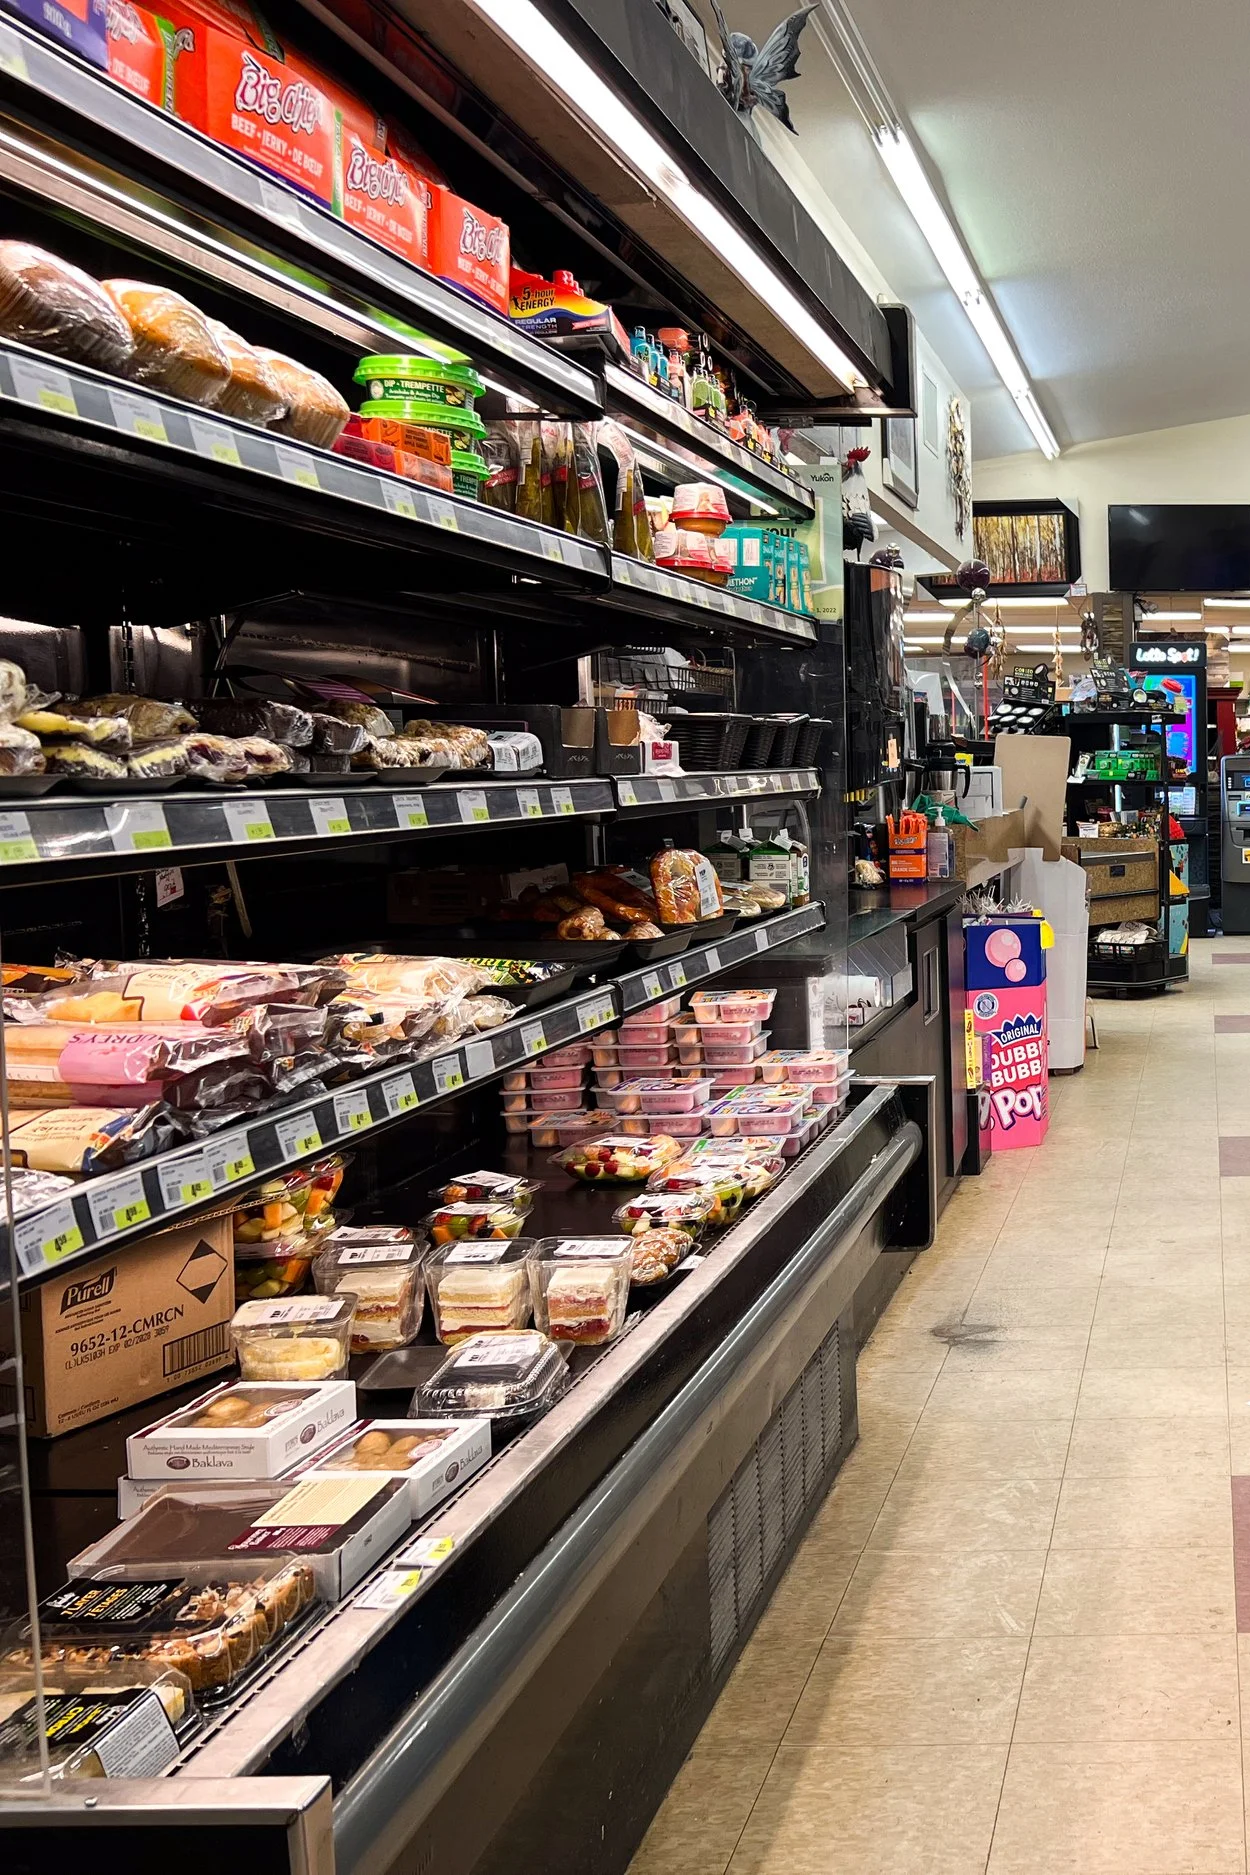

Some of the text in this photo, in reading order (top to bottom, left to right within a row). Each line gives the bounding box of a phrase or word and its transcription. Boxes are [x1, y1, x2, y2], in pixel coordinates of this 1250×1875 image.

[236, 64, 281, 123] Big
[231, 114, 256, 136] BEEF
[262, 130, 288, 156] JERKY
[292, 149, 303, 166] DE
[523, 287, 554, 300] 5-hour
[521, 298, 555, 310] ENERGY
[515, 317, 556, 325] REGULAR
[400, 381, 444, 393] TREMPETTE
[811, 473, 834, 482] Yukon
[1136, 648, 1166, 662] Lotto
[1001, 1024, 1038, 1043] ORIGINAL
[67, 1276, 110, 1305] Purell
[71, 1305, 184, 1356] 9652-12-CMRCN
[317, 1408, 345, 1433] Baklava
[192, 1457, 233, 1468] Baklava
[459, 1444, 483, 1471] Baklava
